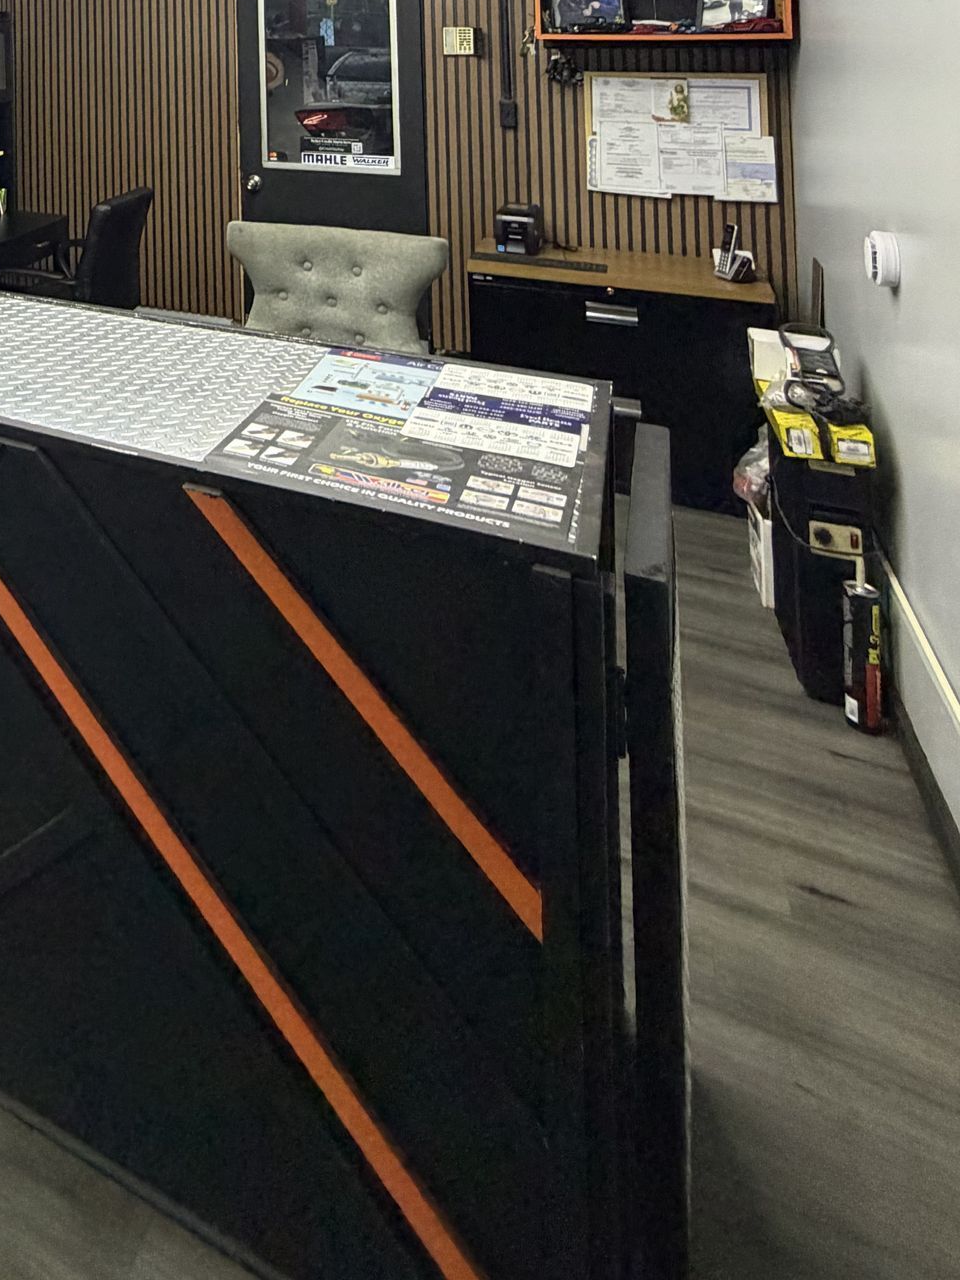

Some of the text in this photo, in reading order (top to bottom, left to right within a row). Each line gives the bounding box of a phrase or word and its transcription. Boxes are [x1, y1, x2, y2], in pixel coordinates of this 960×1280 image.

[303, 154, 389, 167] MAHLE WALKER
[280, 396, 328, 410] Replace
[330, 405, 361, 418] Your
[362, 410, 405, 426] Oxyge
[247, 462, 279, 474] YOUR
[280, 470, 313, 482] FIRST
[313, 479, 360, 493] CHOICE
[377, 494, 436, 512] QUALITY
[436, 507, 511, 529] PRODUCTS
